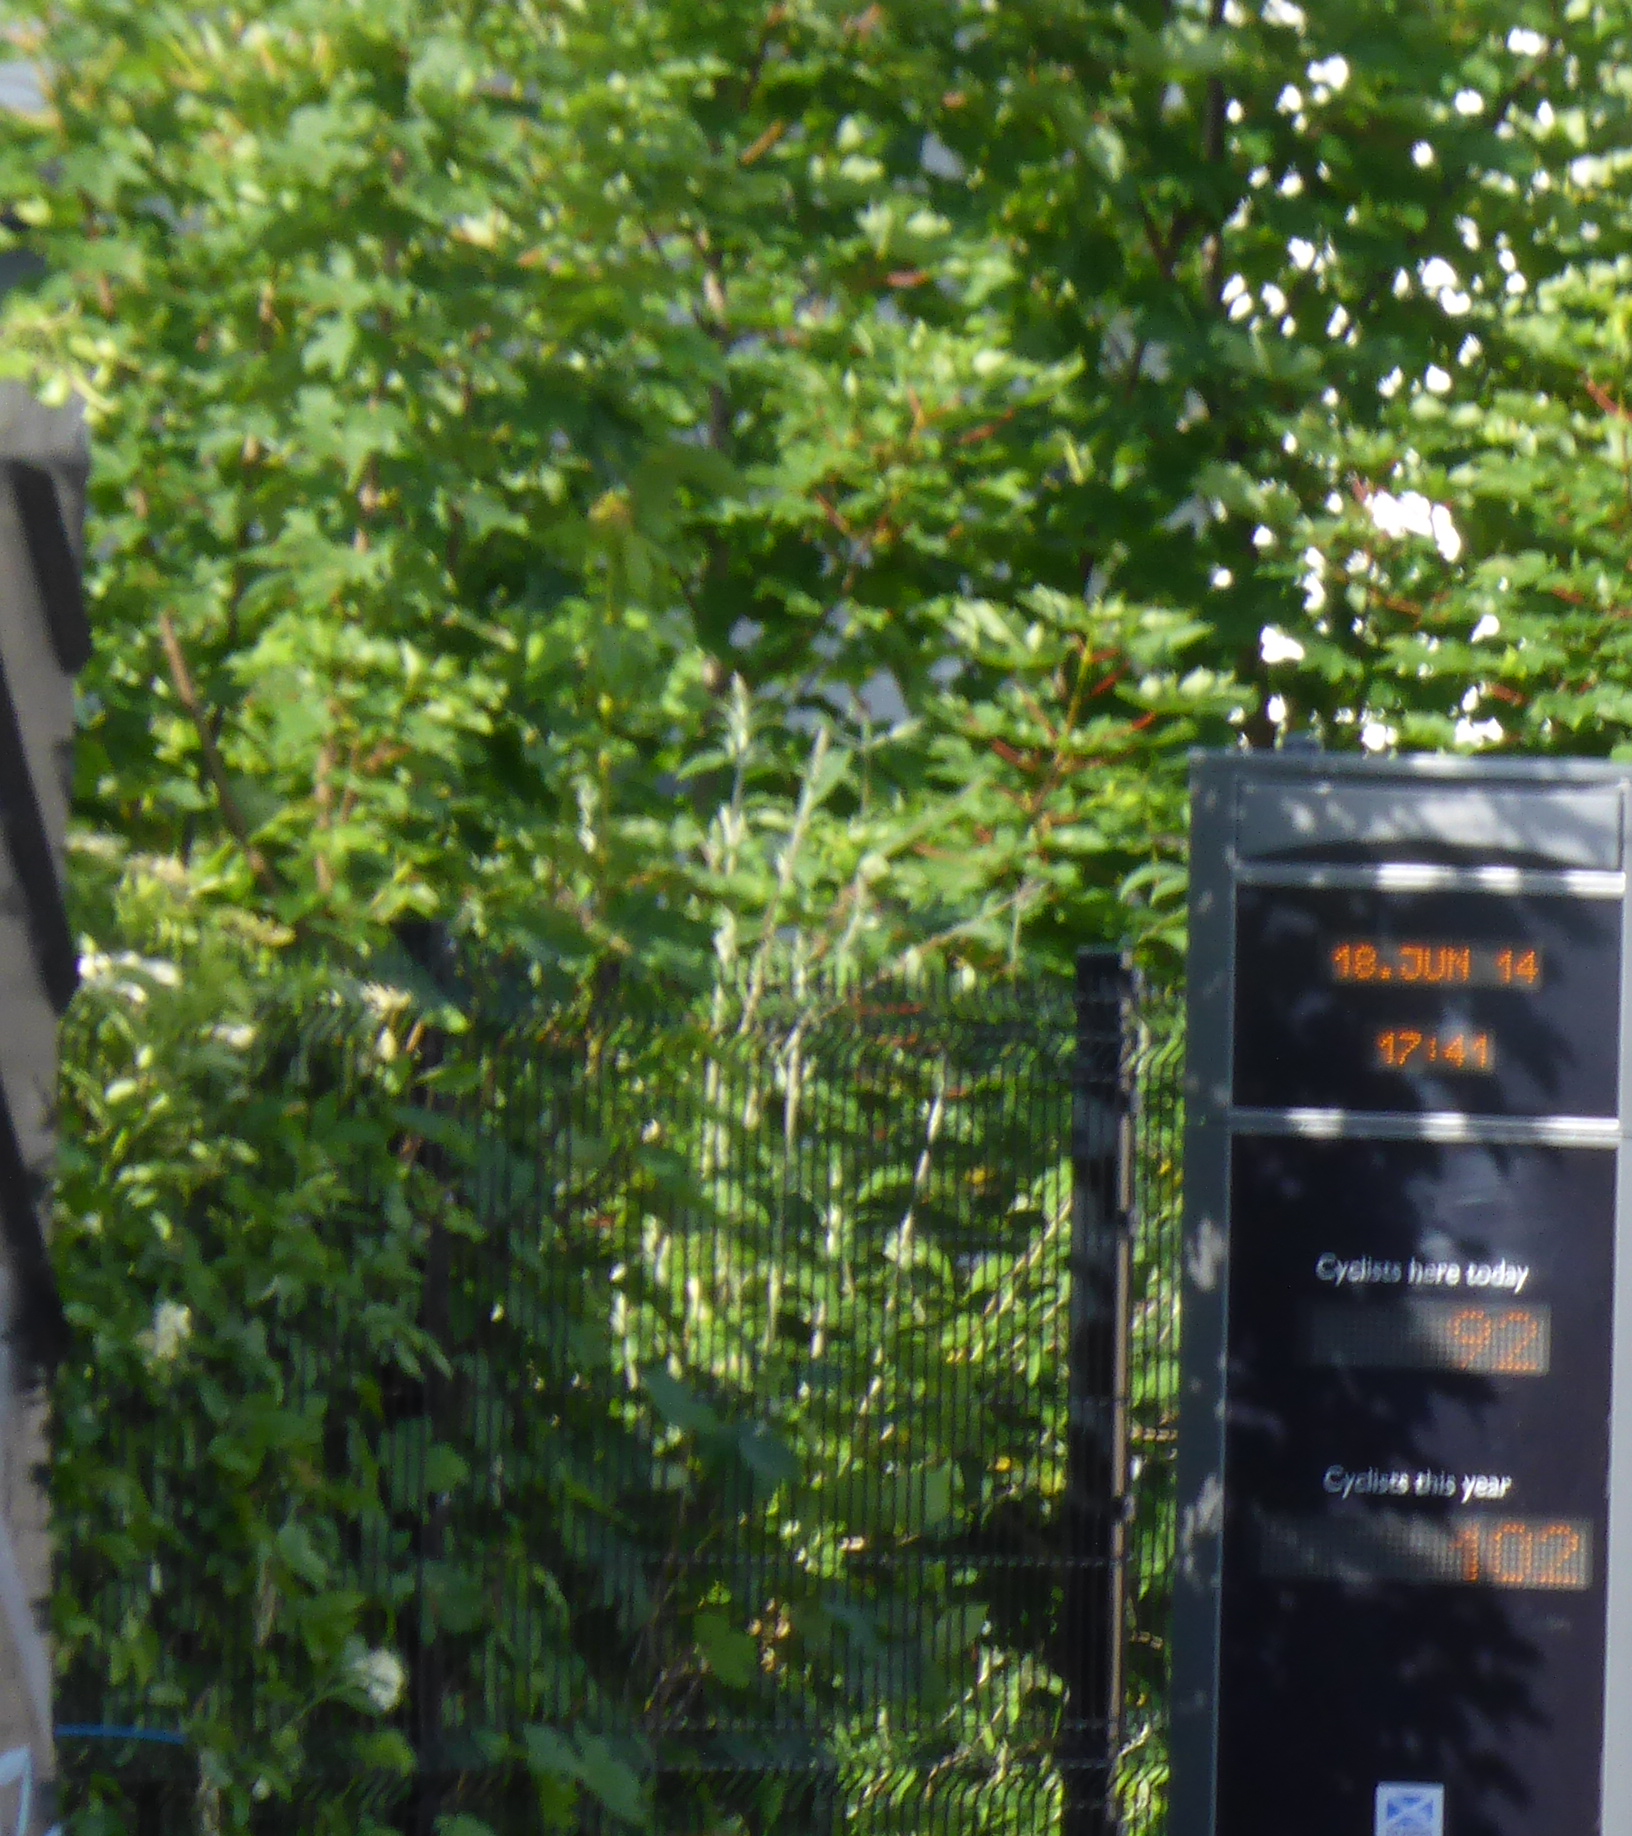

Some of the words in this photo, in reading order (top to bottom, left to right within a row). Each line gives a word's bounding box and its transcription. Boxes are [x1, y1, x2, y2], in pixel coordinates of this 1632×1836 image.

[1496, 948, 1540, 985] 14
[1377, 1029, 1489, 1069] 17:41
[1315, 1252, 1402, 1287] Cyclists
[1407, 1256, 1461, 1287] here
[1466, 1257, 1529, 1294] today
[1447, 1308, 1539, 1372] 92
[1323, 1464, 1409, 1500] Cyclists
[1414, 1467, 1457, 1497] this
[1462, 1473, 1513, 1504] year
[1450, 1522, 1581, 1584] 102
